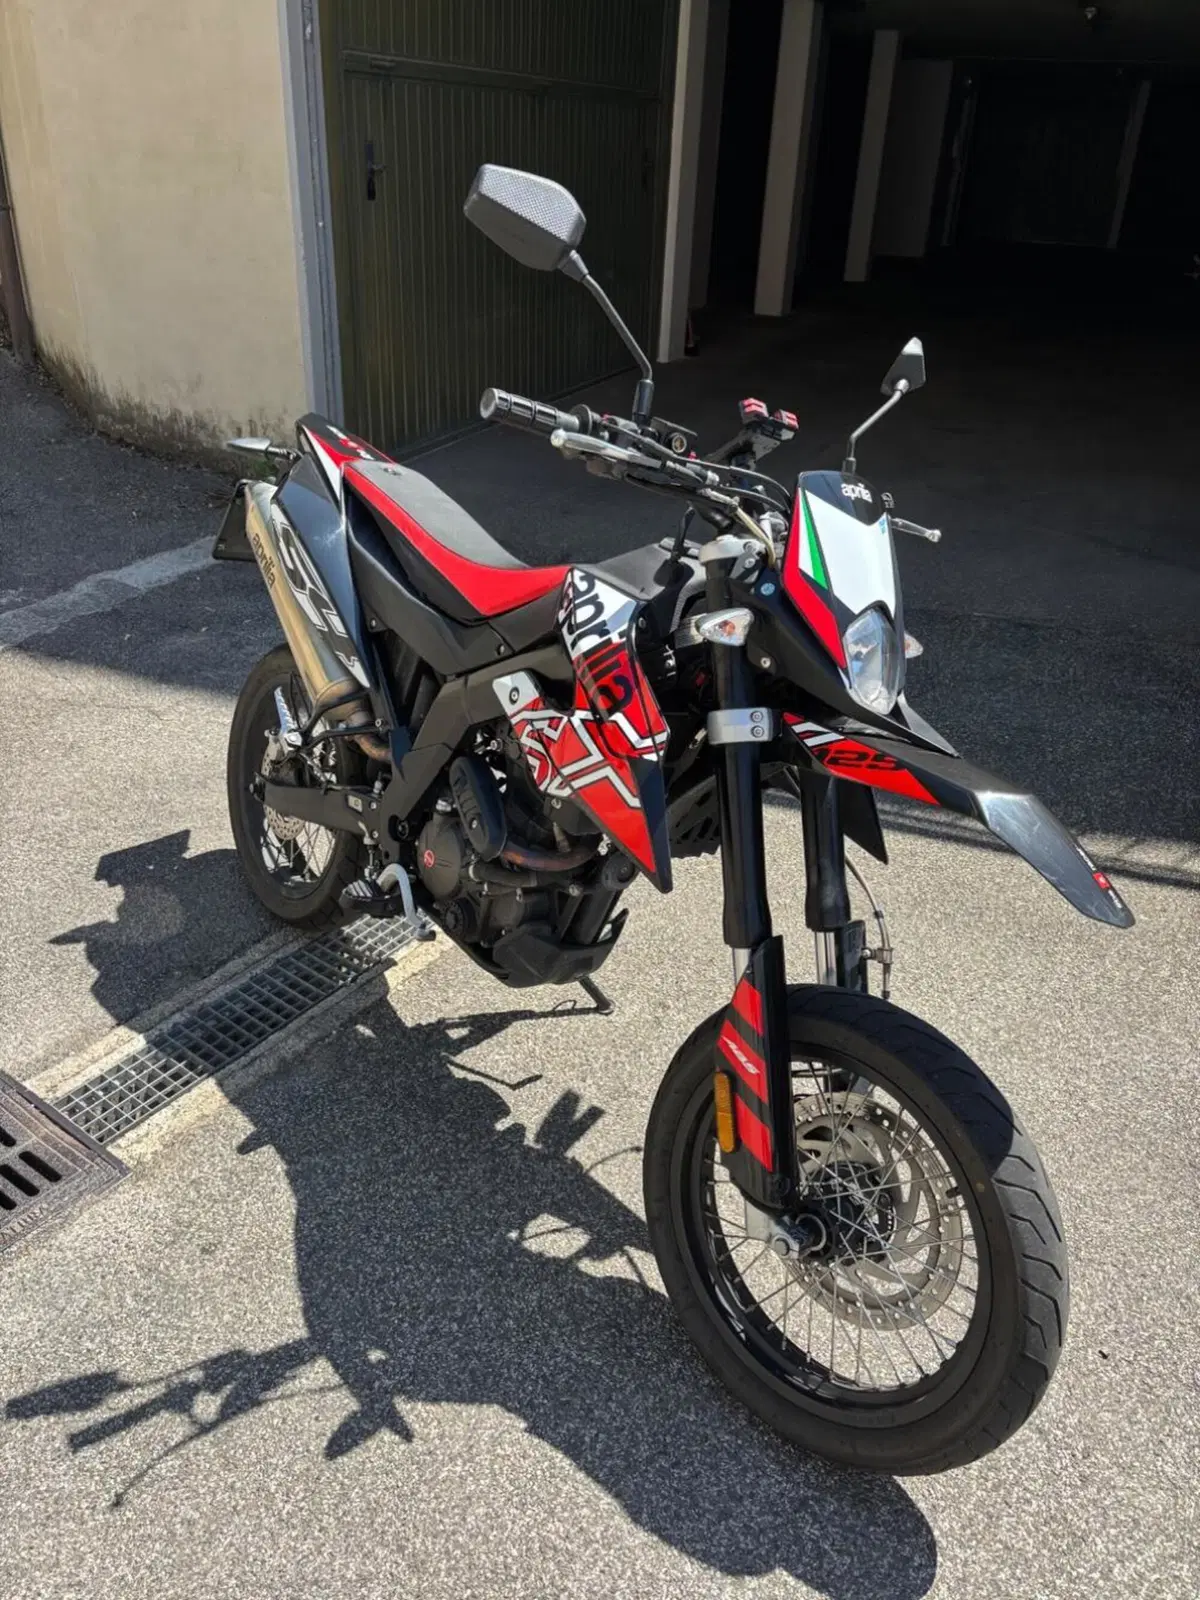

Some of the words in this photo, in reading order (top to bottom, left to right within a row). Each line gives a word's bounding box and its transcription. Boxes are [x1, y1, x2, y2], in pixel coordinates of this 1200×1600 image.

[251, 532, 277, 589] aprilia
[559, 570, 634, 720] aprilia
[812, 748, 902, 771] 125
